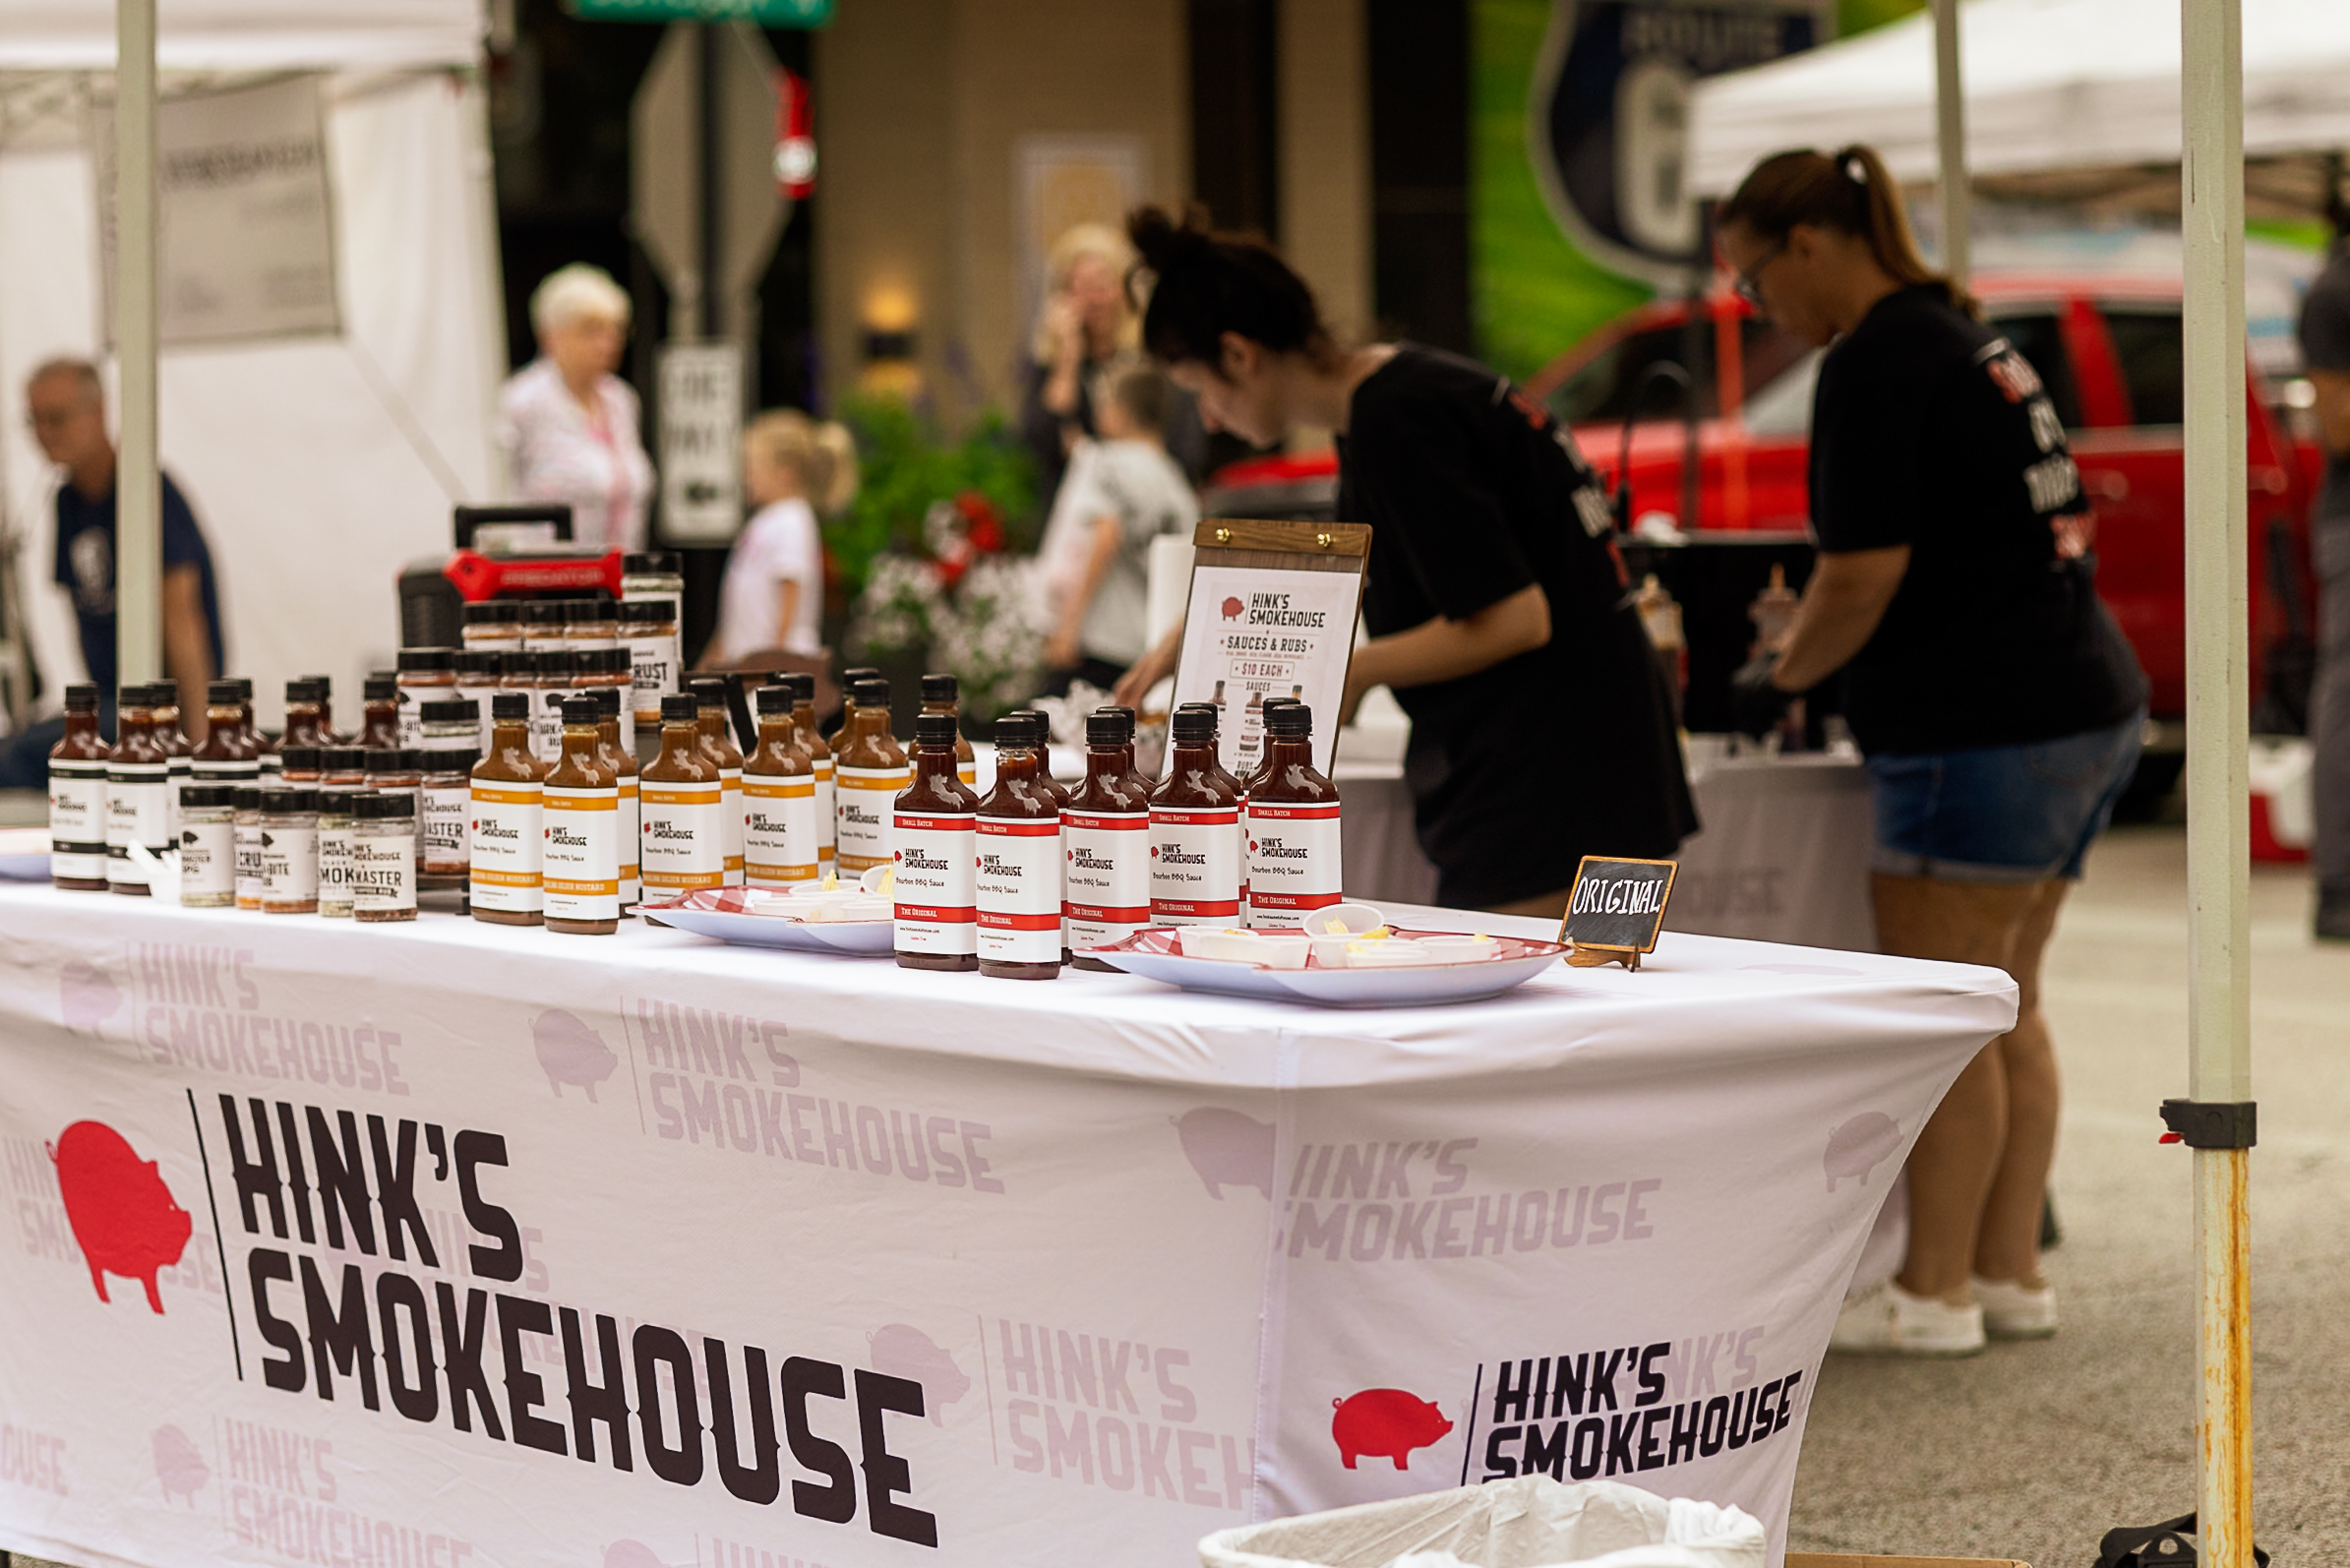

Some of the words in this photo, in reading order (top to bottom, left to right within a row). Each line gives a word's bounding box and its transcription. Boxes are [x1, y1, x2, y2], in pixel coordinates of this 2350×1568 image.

[1252, 592, 1290, 609] HINK'S
[1249, 610, 1325, 628] SMOKEHOUSE
[1228, 636, 1267, 650] SAUCES
[1271, 638, 1277, 650] &
[1281, 638, 1307, 652] RUBS
[1242, 663, 1257, 675] $10
[1260, 664, 1283, 677] EACH
[1246, 682, 1271, 692] SAUCES
[654, 830, 693, 839] SMOKEHOUSE
[1262, 838, 1282, 848] HINK'S
[905, 848, 925, 859] HINK'S
[1076, 848, 1092, 858] HINK'S
[1163, 844, 1180, 854] HINK'S
[1262, 848, 1307, 858] SMOKEHOUSE
[905, 859, 948, 870] SMOKEHOUSE
[984, 855, 999, 865] HINK'S
[1076, 858, 1114, 870] SMOKEHOUSE
[1163, 854, 1205, 865] SMOKEHOUSE
[984, 865, 1022, 876] SMOKEHOUSE
[915, 878, 928, 887] BBQ
[1172, 874, 1184, 882] BBQ
[1573, 876, 1662, 915] ORIGINAL
[901, 907, 911, 916] THE
[912, 908, 937, 918] ORIGINAL
[1082, 908, 1103, 918] ORIGINAL
[990, 916, 1012, 925] ORIGINAL
[141, 941, 258, 1011] HINK'S
[637, 997, 800, 1088] HINK'S
[146, 1007, 410, 1096] SMOKEHOUSE
[649, 1071, 1005, 1195] SMOKEHOUSE
[217, 1093, 523, 1283] HINK'S
[999, 1318, 1197, 1424] HINK'S
[1493, 1342, 1670, 1423] HINK'S
[247, 1247, 937, 1547] SMOKEHOUSE
[1481, 1369, 1802, 1483] SMOKEHOUSE
[226, 1417, 337, 1503] HINK'S
